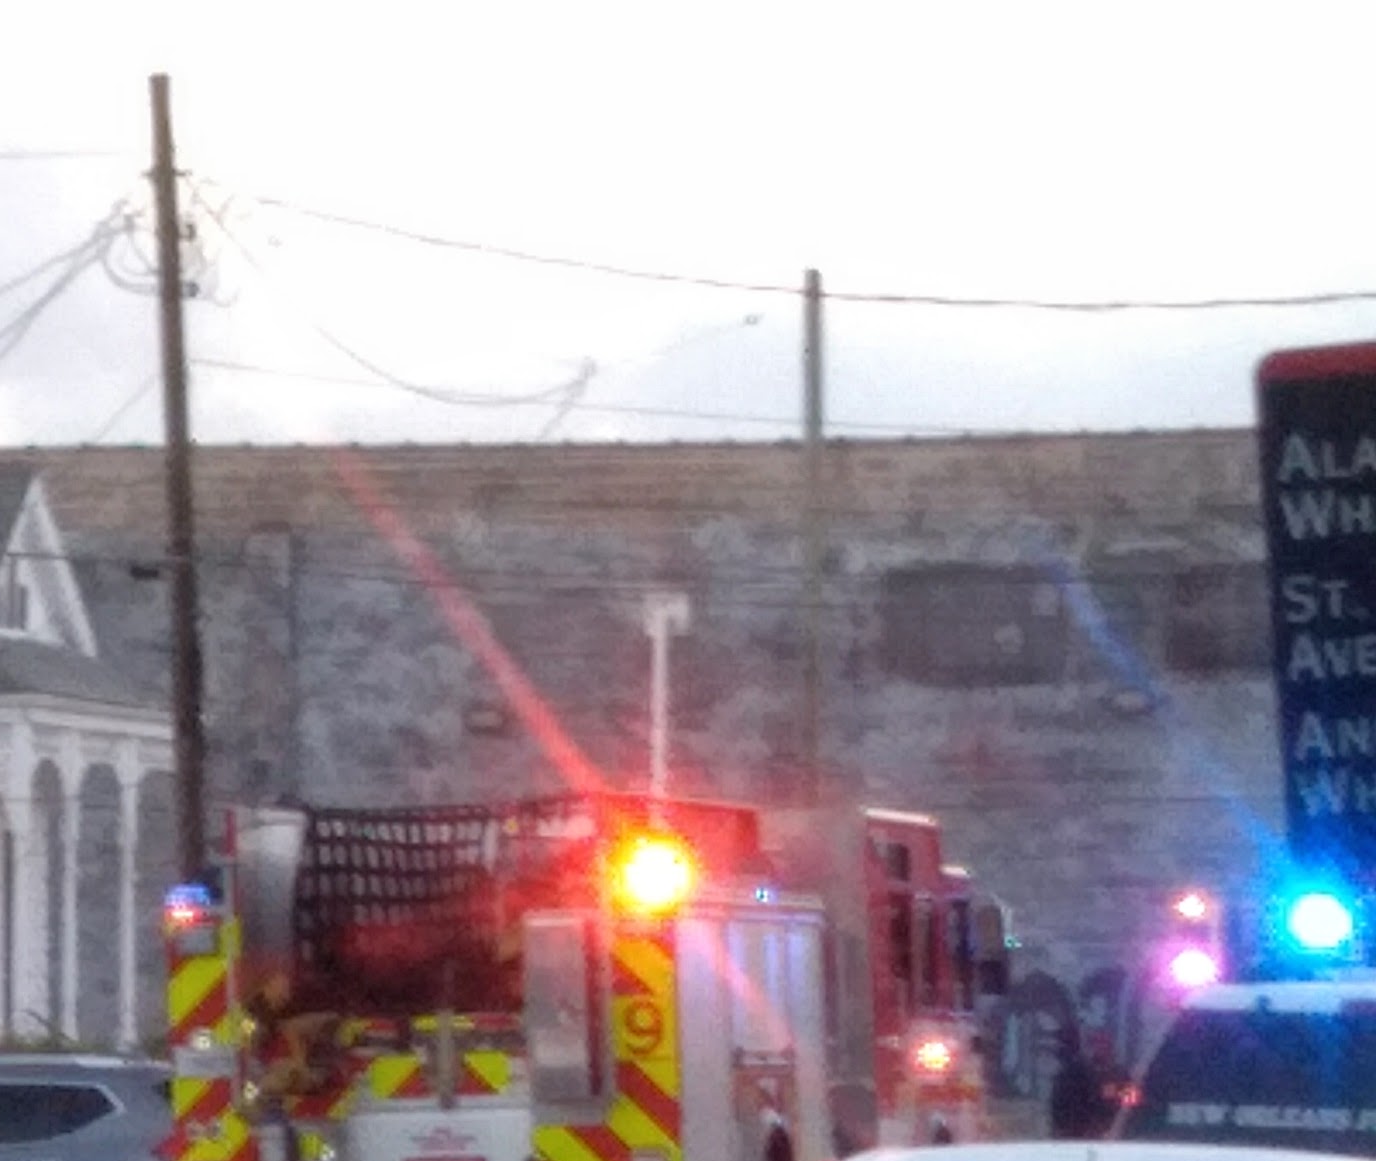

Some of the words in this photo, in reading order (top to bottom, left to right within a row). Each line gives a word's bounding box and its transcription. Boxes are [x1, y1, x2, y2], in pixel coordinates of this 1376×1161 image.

[624, 1001, 664, 1056] 9
[1167, 1102, 1226, 1125] NEW
[1234, 1104, 1352, 1130] ORLEANS
